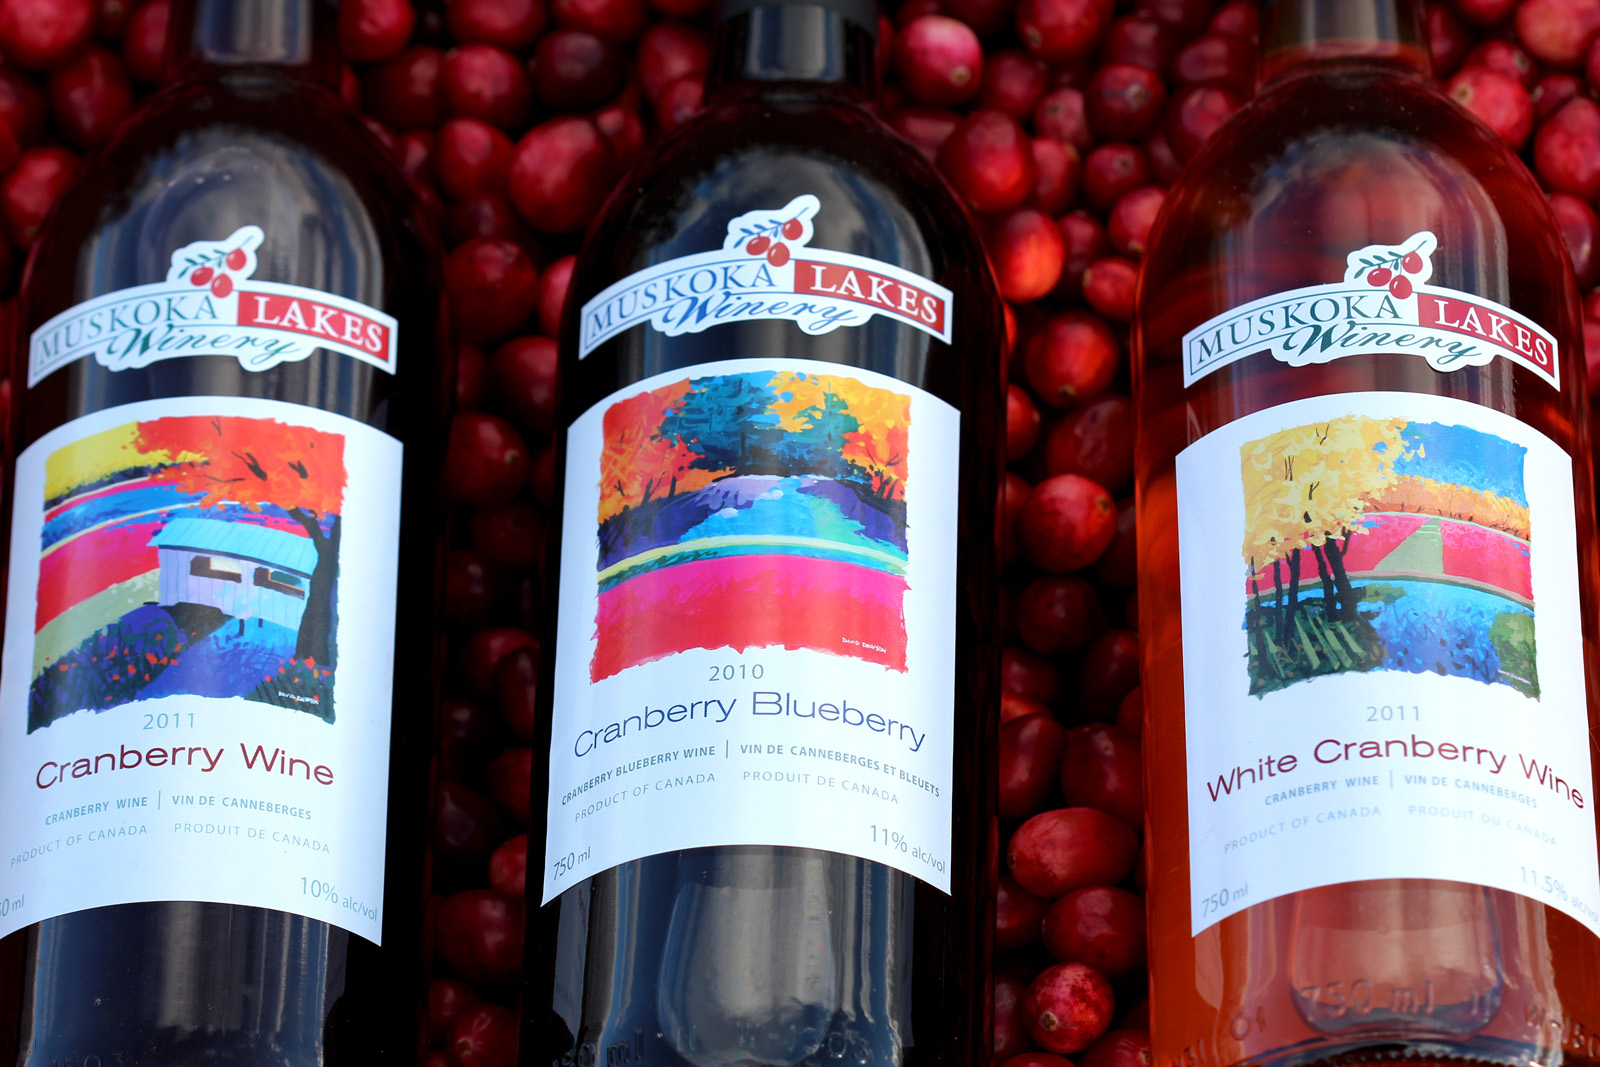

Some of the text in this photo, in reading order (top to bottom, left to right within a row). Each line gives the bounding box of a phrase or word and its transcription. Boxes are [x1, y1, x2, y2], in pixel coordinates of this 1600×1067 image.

[589, 262, 938, 339] MUSKOKA LAKES
[662, 290, 860, 331] Winery
[38, 294, 383, 365] MUSKOKA LAKES
[107, 323, 301, 365] Winery
[1197, 294, 1548, 366] MUSKOKA LAKES
[1283, 320, 1482, 365] Winery
[708, 663, 765, 683] 2010
[143, 712, 196, 730] 2011
[573, 691, 926, 759] Cranberry Blueberry
[1366, 705, 1421, 722] 2011
[35, 742, 335, 789] Cranberry Wine
[561, 744, 941, 806] CRANBERRY BLUEBERRY WINE VIN DE CANNEBERGES ET BLEUETS
[1207, 734, 1584, 809] White Cranberry Wine
[45, 795, 312, 826] CRANBERRY WINE VIN DE CANNEBERGES
[575, 771, 899, 823] PRODUCT OF CANADA PRODUIT DE CANADA
[1265, 774, 1537, 809] CRANBERRY WINE VIN DE CANNEBERGES
[10, 822, 330, 869] PRODUCT OF CANADA PRODUIT DE CANADA
[870, 825, 946, 875] 11% alc/vol
[1224, 805, 1557, 854] PRODUCT OF CANADA PRODUIT DU CANADA
[552, 846, 592, 882] 750 ml
[1520, 866, 1569, 902] 11.5%
[11, 894, 25, 913] ml
[300, 876, 379, 923] 10% alc/vol
[1201, 883, 1249, 918] 750 ml
